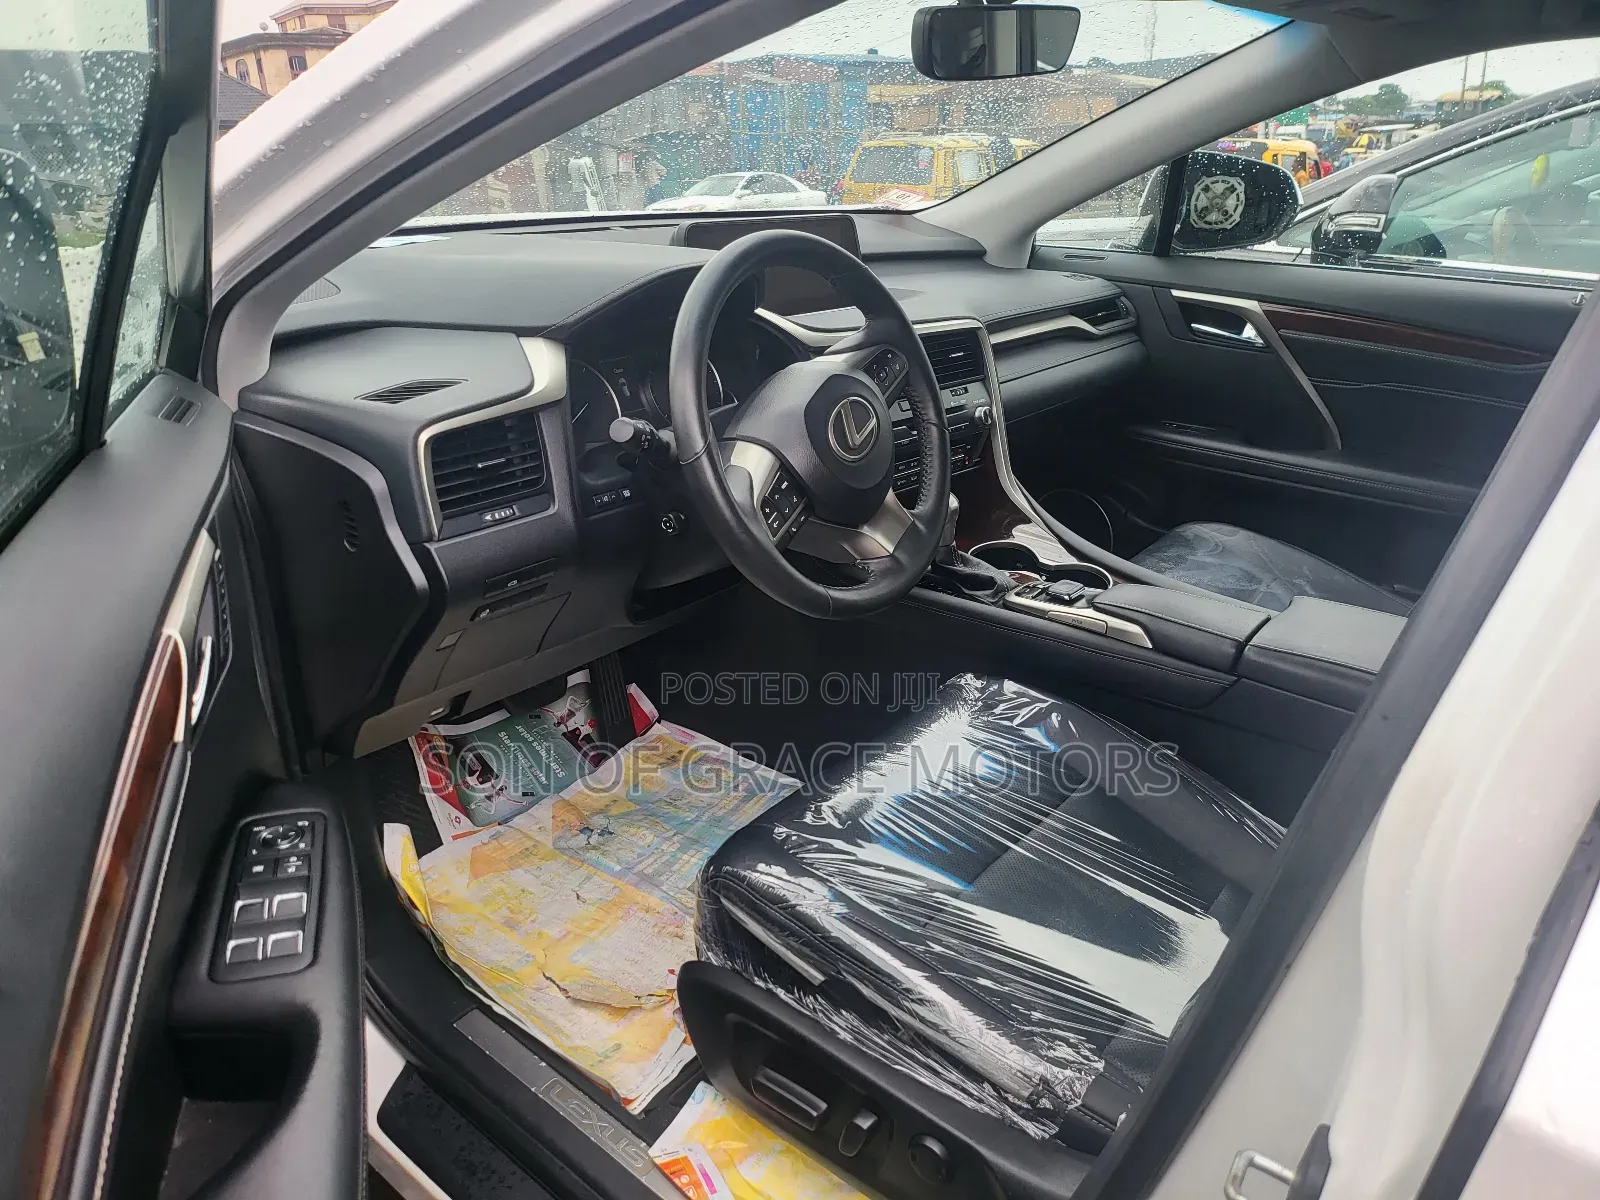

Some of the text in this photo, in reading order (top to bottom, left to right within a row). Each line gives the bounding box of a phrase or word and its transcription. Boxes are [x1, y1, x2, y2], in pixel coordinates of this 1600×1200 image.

[514, 724, 534, 742] solar
[498, 731, 532, 768] StarTimes
[530, 768, 549, 785] solar
[532, 741, 566, 778] StarTimes
